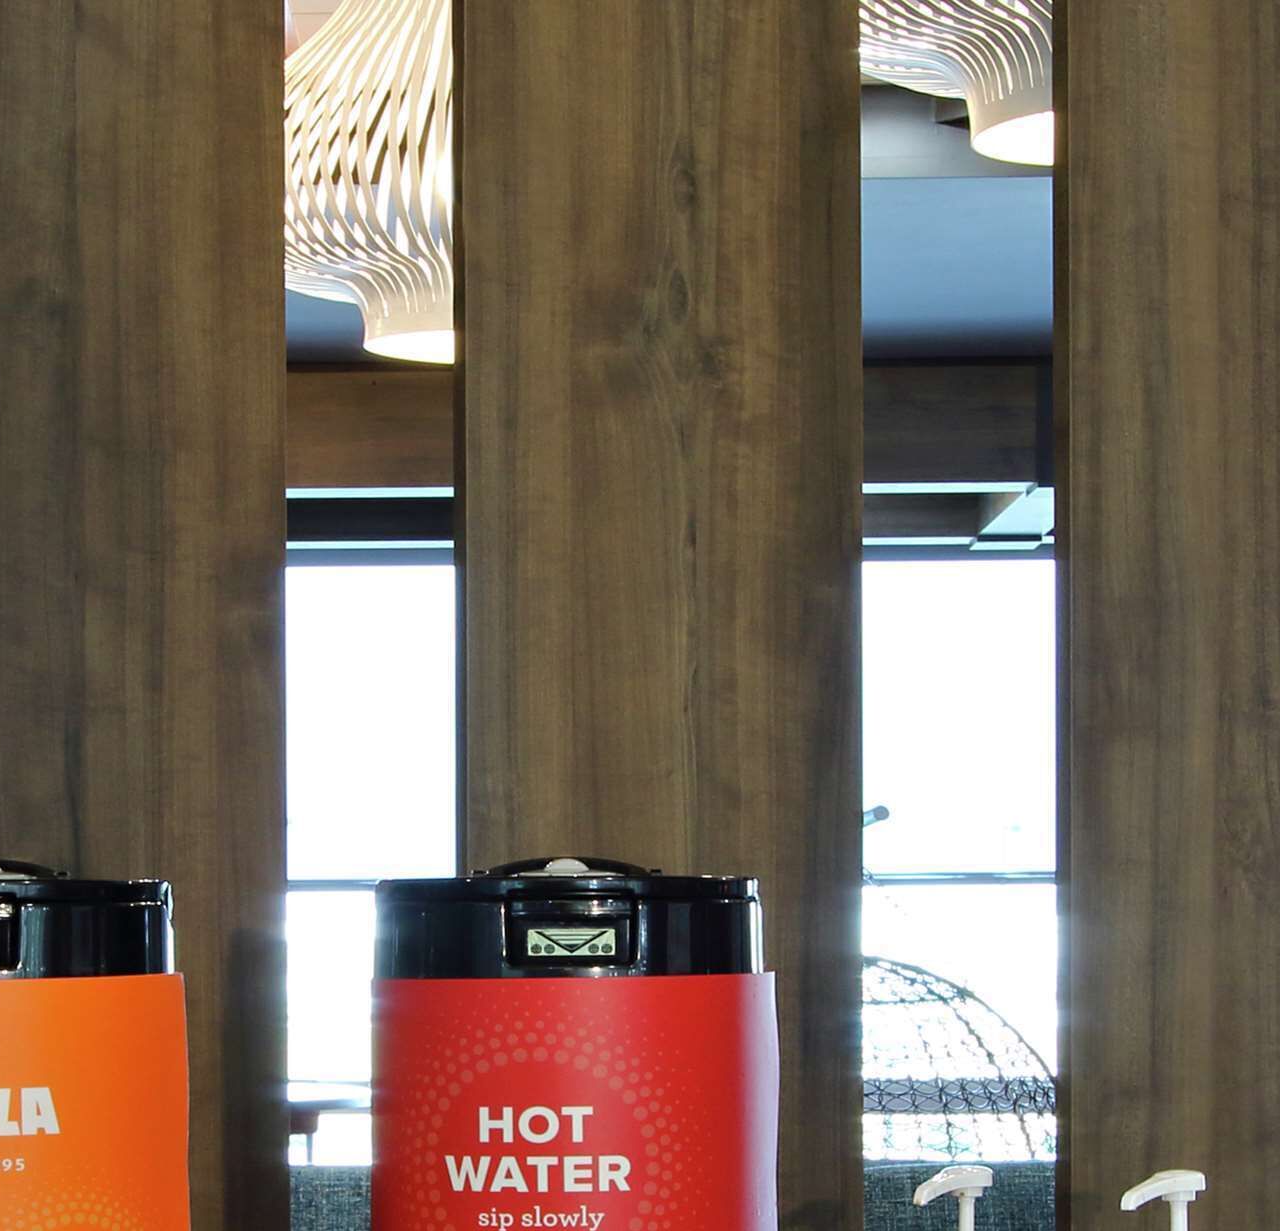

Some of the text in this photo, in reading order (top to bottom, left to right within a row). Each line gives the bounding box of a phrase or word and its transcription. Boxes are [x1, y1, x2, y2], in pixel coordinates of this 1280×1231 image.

[479, 1105, 594, 1144] HOT
[445, 1154, 632, 1193] WATER
[478, 1206, 514, 1231] sip
